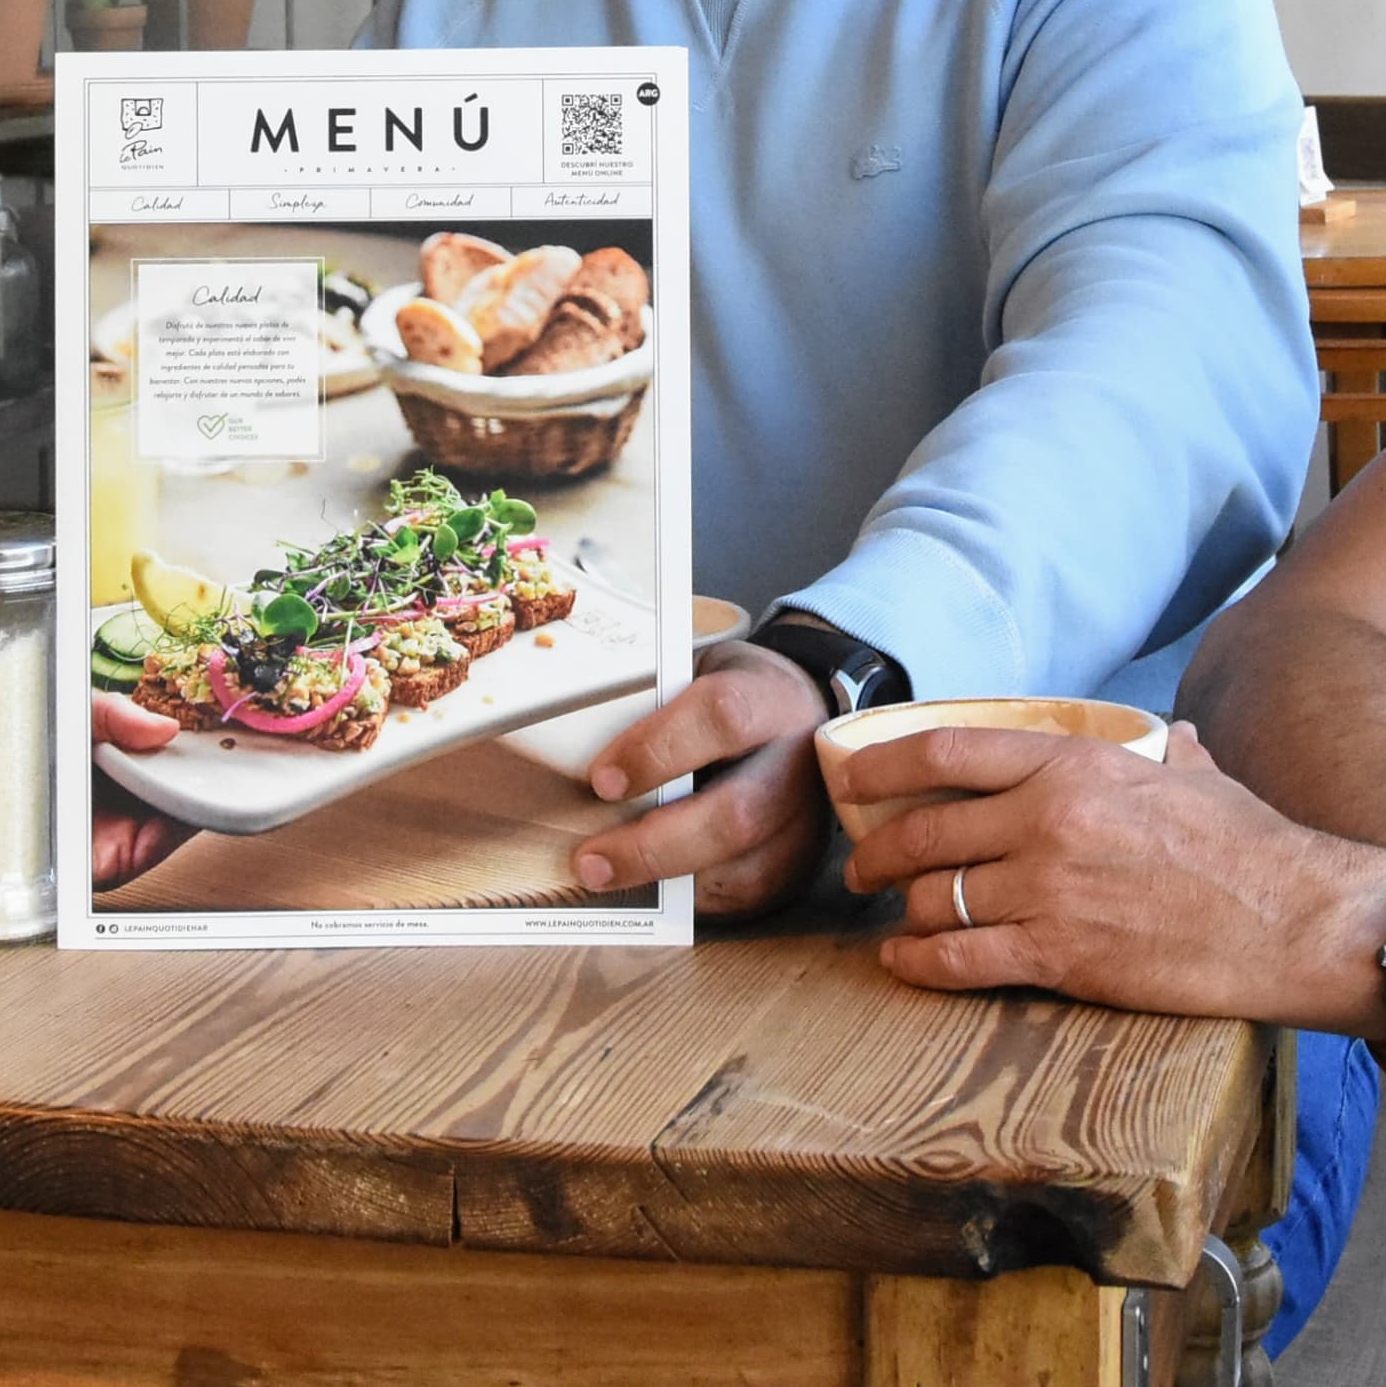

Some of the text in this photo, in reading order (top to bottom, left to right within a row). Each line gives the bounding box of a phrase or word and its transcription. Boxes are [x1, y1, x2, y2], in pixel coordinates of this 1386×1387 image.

[637, 89, 659, 99] ARG
[250, 92, 489, 153] MENÚ
[561, 160, 597, 169] DESCUBRÍ
[131, 195, 184, 212] Calidad
[405, 192, 475, 209] Comunidad
[544, 191, 621, 207] Autenticidad
[191, 285, 263, 307] Calidad
[311, 920, 323, 929] No
[364, 920, 394, 928] servicio
[395, 920, 405, 928] de
[525, 920, 654, 929] WWW.LEPAINQUOTIDIEN.COM.AR
